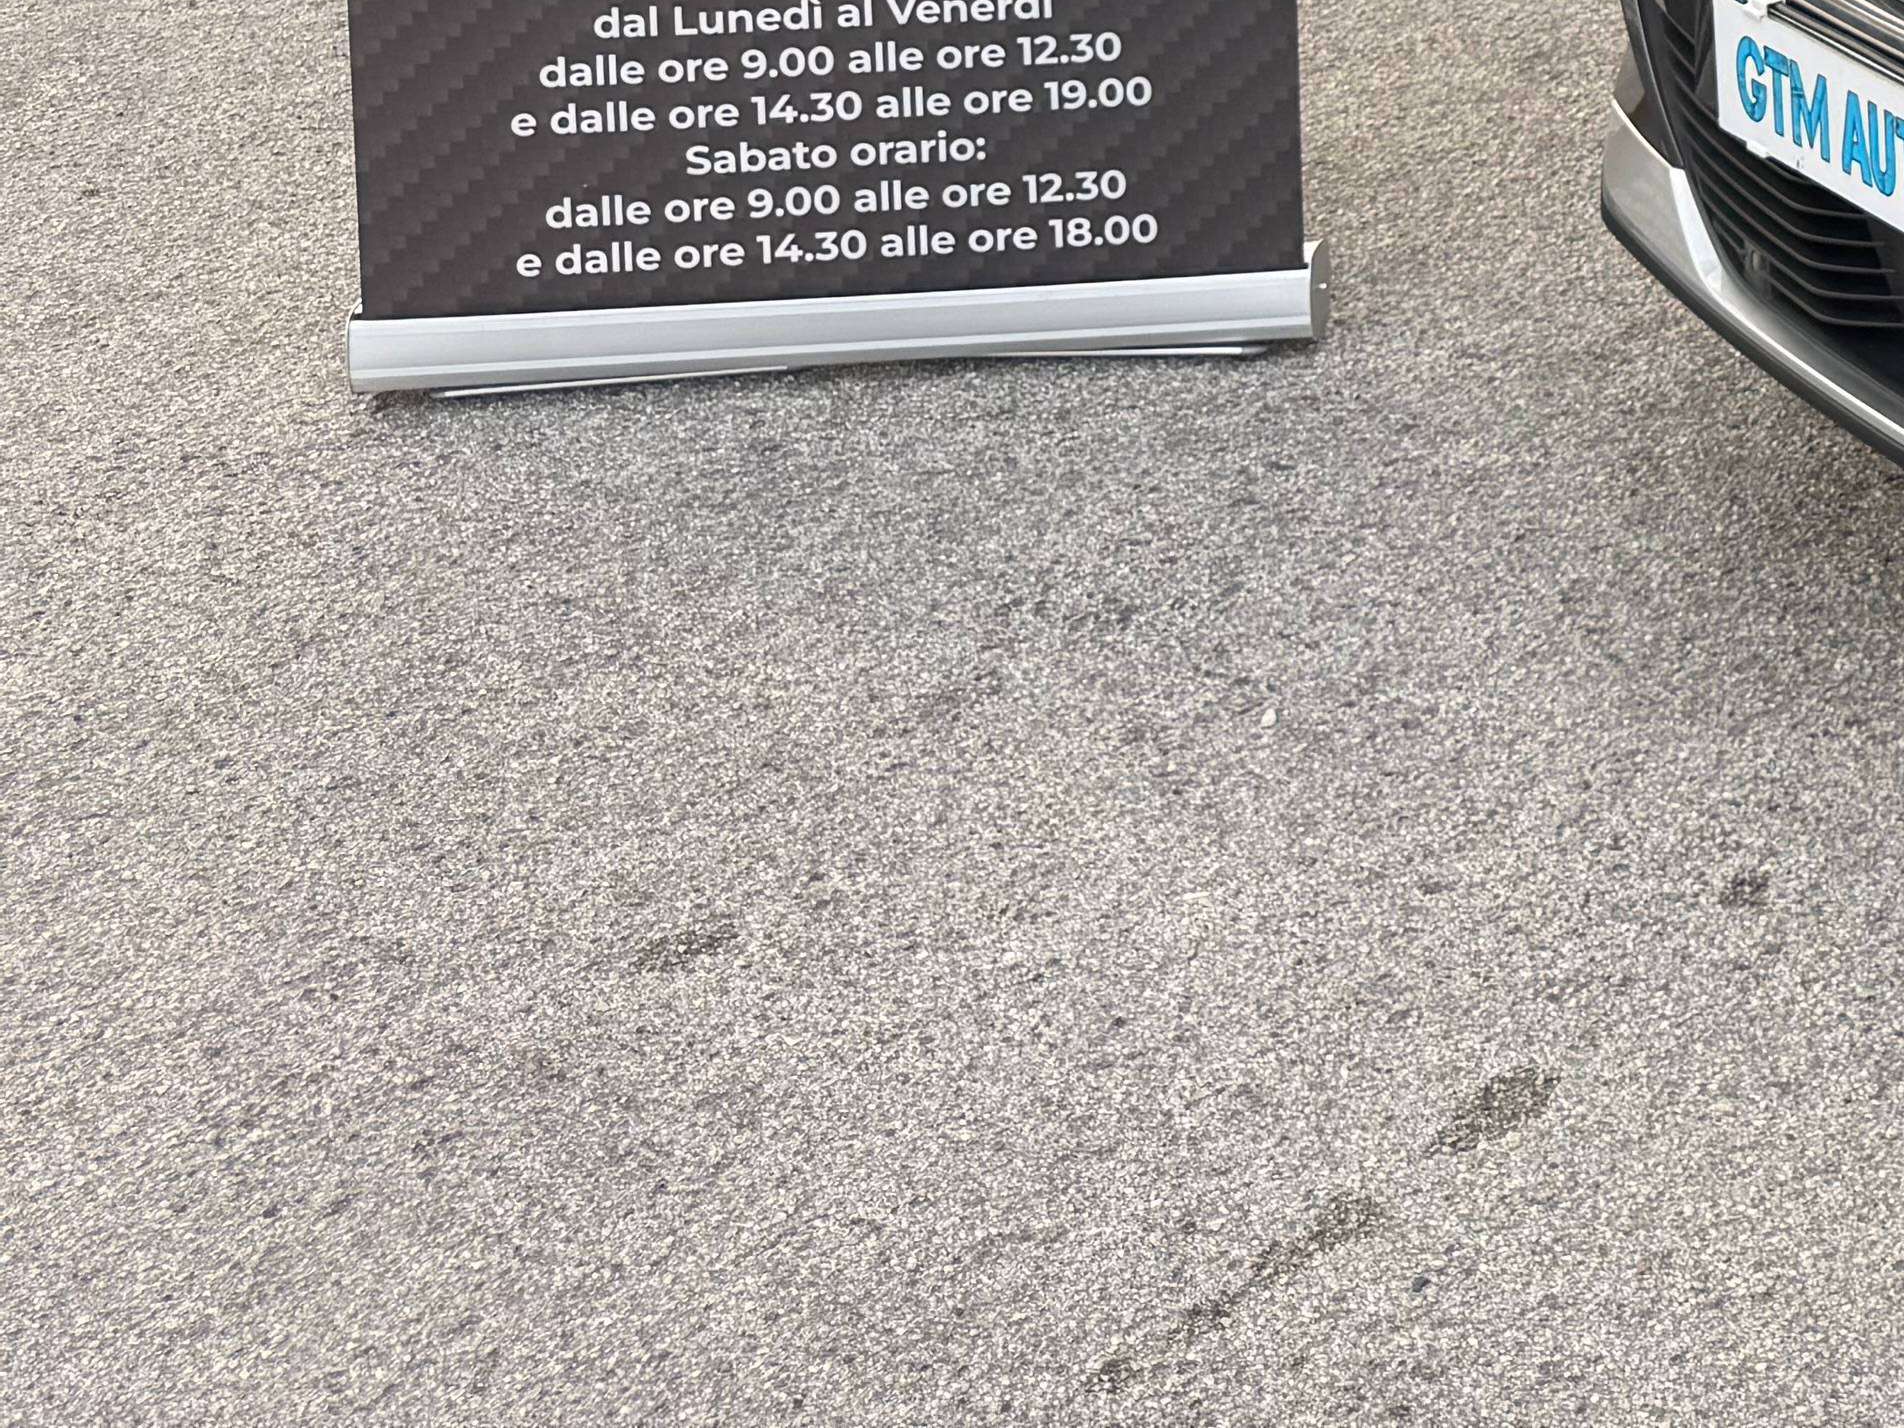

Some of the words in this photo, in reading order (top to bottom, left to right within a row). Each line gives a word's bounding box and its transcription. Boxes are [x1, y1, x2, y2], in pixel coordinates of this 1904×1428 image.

[593, 5, 658, 39] dal
[539, 53, 645, 88] dalle
[657, 57, 729, 83] ore
[740, 45, 835, 80] 9.00
[848, 40, 924, 74] alle
[936, 44, 1006, 70] ore
[1016, 31, 1122, 66] 12.30
[510, 112, 537, 137] e
[550, 100, 656, 135] dalle
[668, 103, 740, 130] ore
[750, 90, 863, 125] 14.30
[875, 85, 952, 119] alle
[963, 88, 1034, 115] ore
[1043, 76, 1152, 111] 19.00
[1736, 35, 1830, 163] GTM
[685, 141, 838, 176] Sabato
[850, 129, 986, 167] orario:
[545, 194, 652, 229] dalle
[664, 196, 736, 223] ore
[747, 184, 841, 219] 9.00
[853, 179, 930, 213] alle
[942, 182, 1012, 208] ore
[1022, 169, 1127, 204] 12.30
[516, 253, 542, 277] e
[555, 240, 661, 275] dalle
[674, 242, 745, 269] ore
[755, 229, 867, 265] 14.30
[880, 224, 956, 258] alle
[968, 226, 1038, 253] ore
[1048, 213, 1158, 249] 18.00
